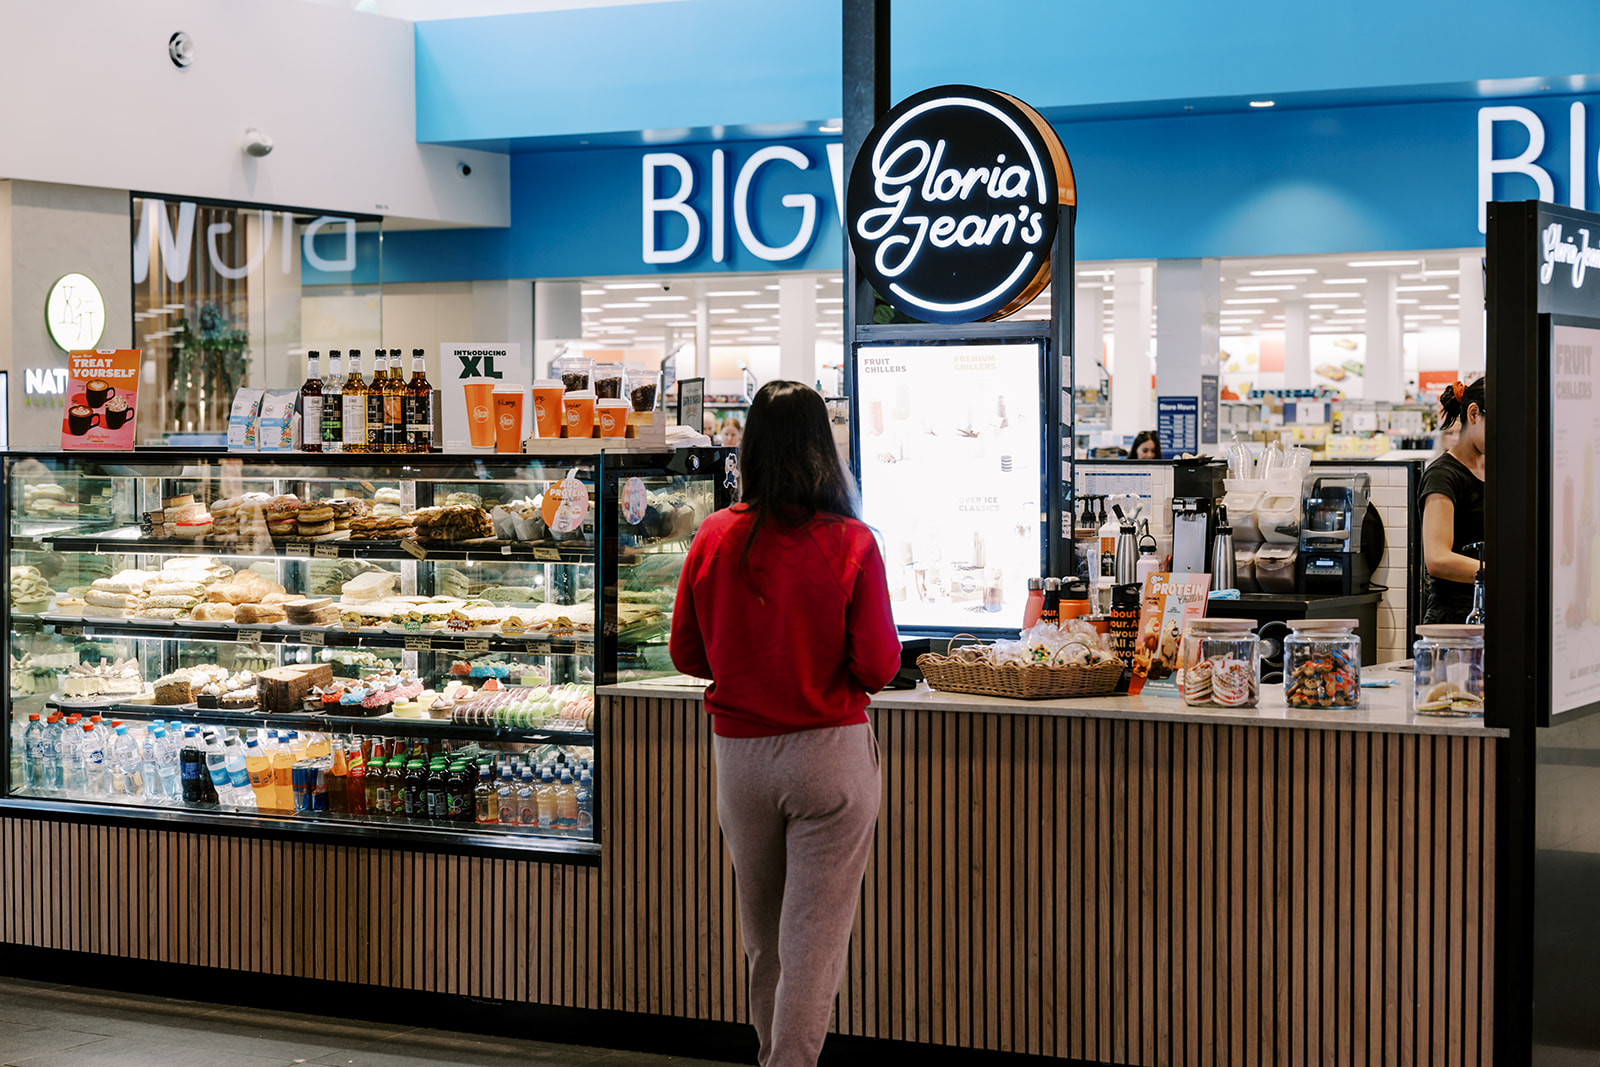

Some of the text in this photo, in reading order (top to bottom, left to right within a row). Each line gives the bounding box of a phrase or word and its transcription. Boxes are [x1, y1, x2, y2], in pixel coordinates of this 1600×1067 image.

[1478, 101, 1600, 234] BI
[856, 139, 1030, 240] Gloria
[642, 145, 817, 264] BIG
[875, 205, 1042, 277] Jean's
[73, 358, 113, 368] TREAT
[864, 358, 890, 366] FRUIT
[954, 355, 996, 363] PREMIUM
[1556, 344, 1592, 376] FRUIT
[458, 356, 503, 379] XL
[865, 365, 907, 374] CHILLERS
[954, 362, 997, 371] CHILLERS
[72, 368, 136, 378] YOURSELF
[1160, 403, 1176, 411] Store
[560, 480, 579, 488] ADD
[549, 488, 586, 497] PROTEIN
[959, 504, 1000, 512] CLASSICS
[1152, 583, 1204, 596] PROTEIN
